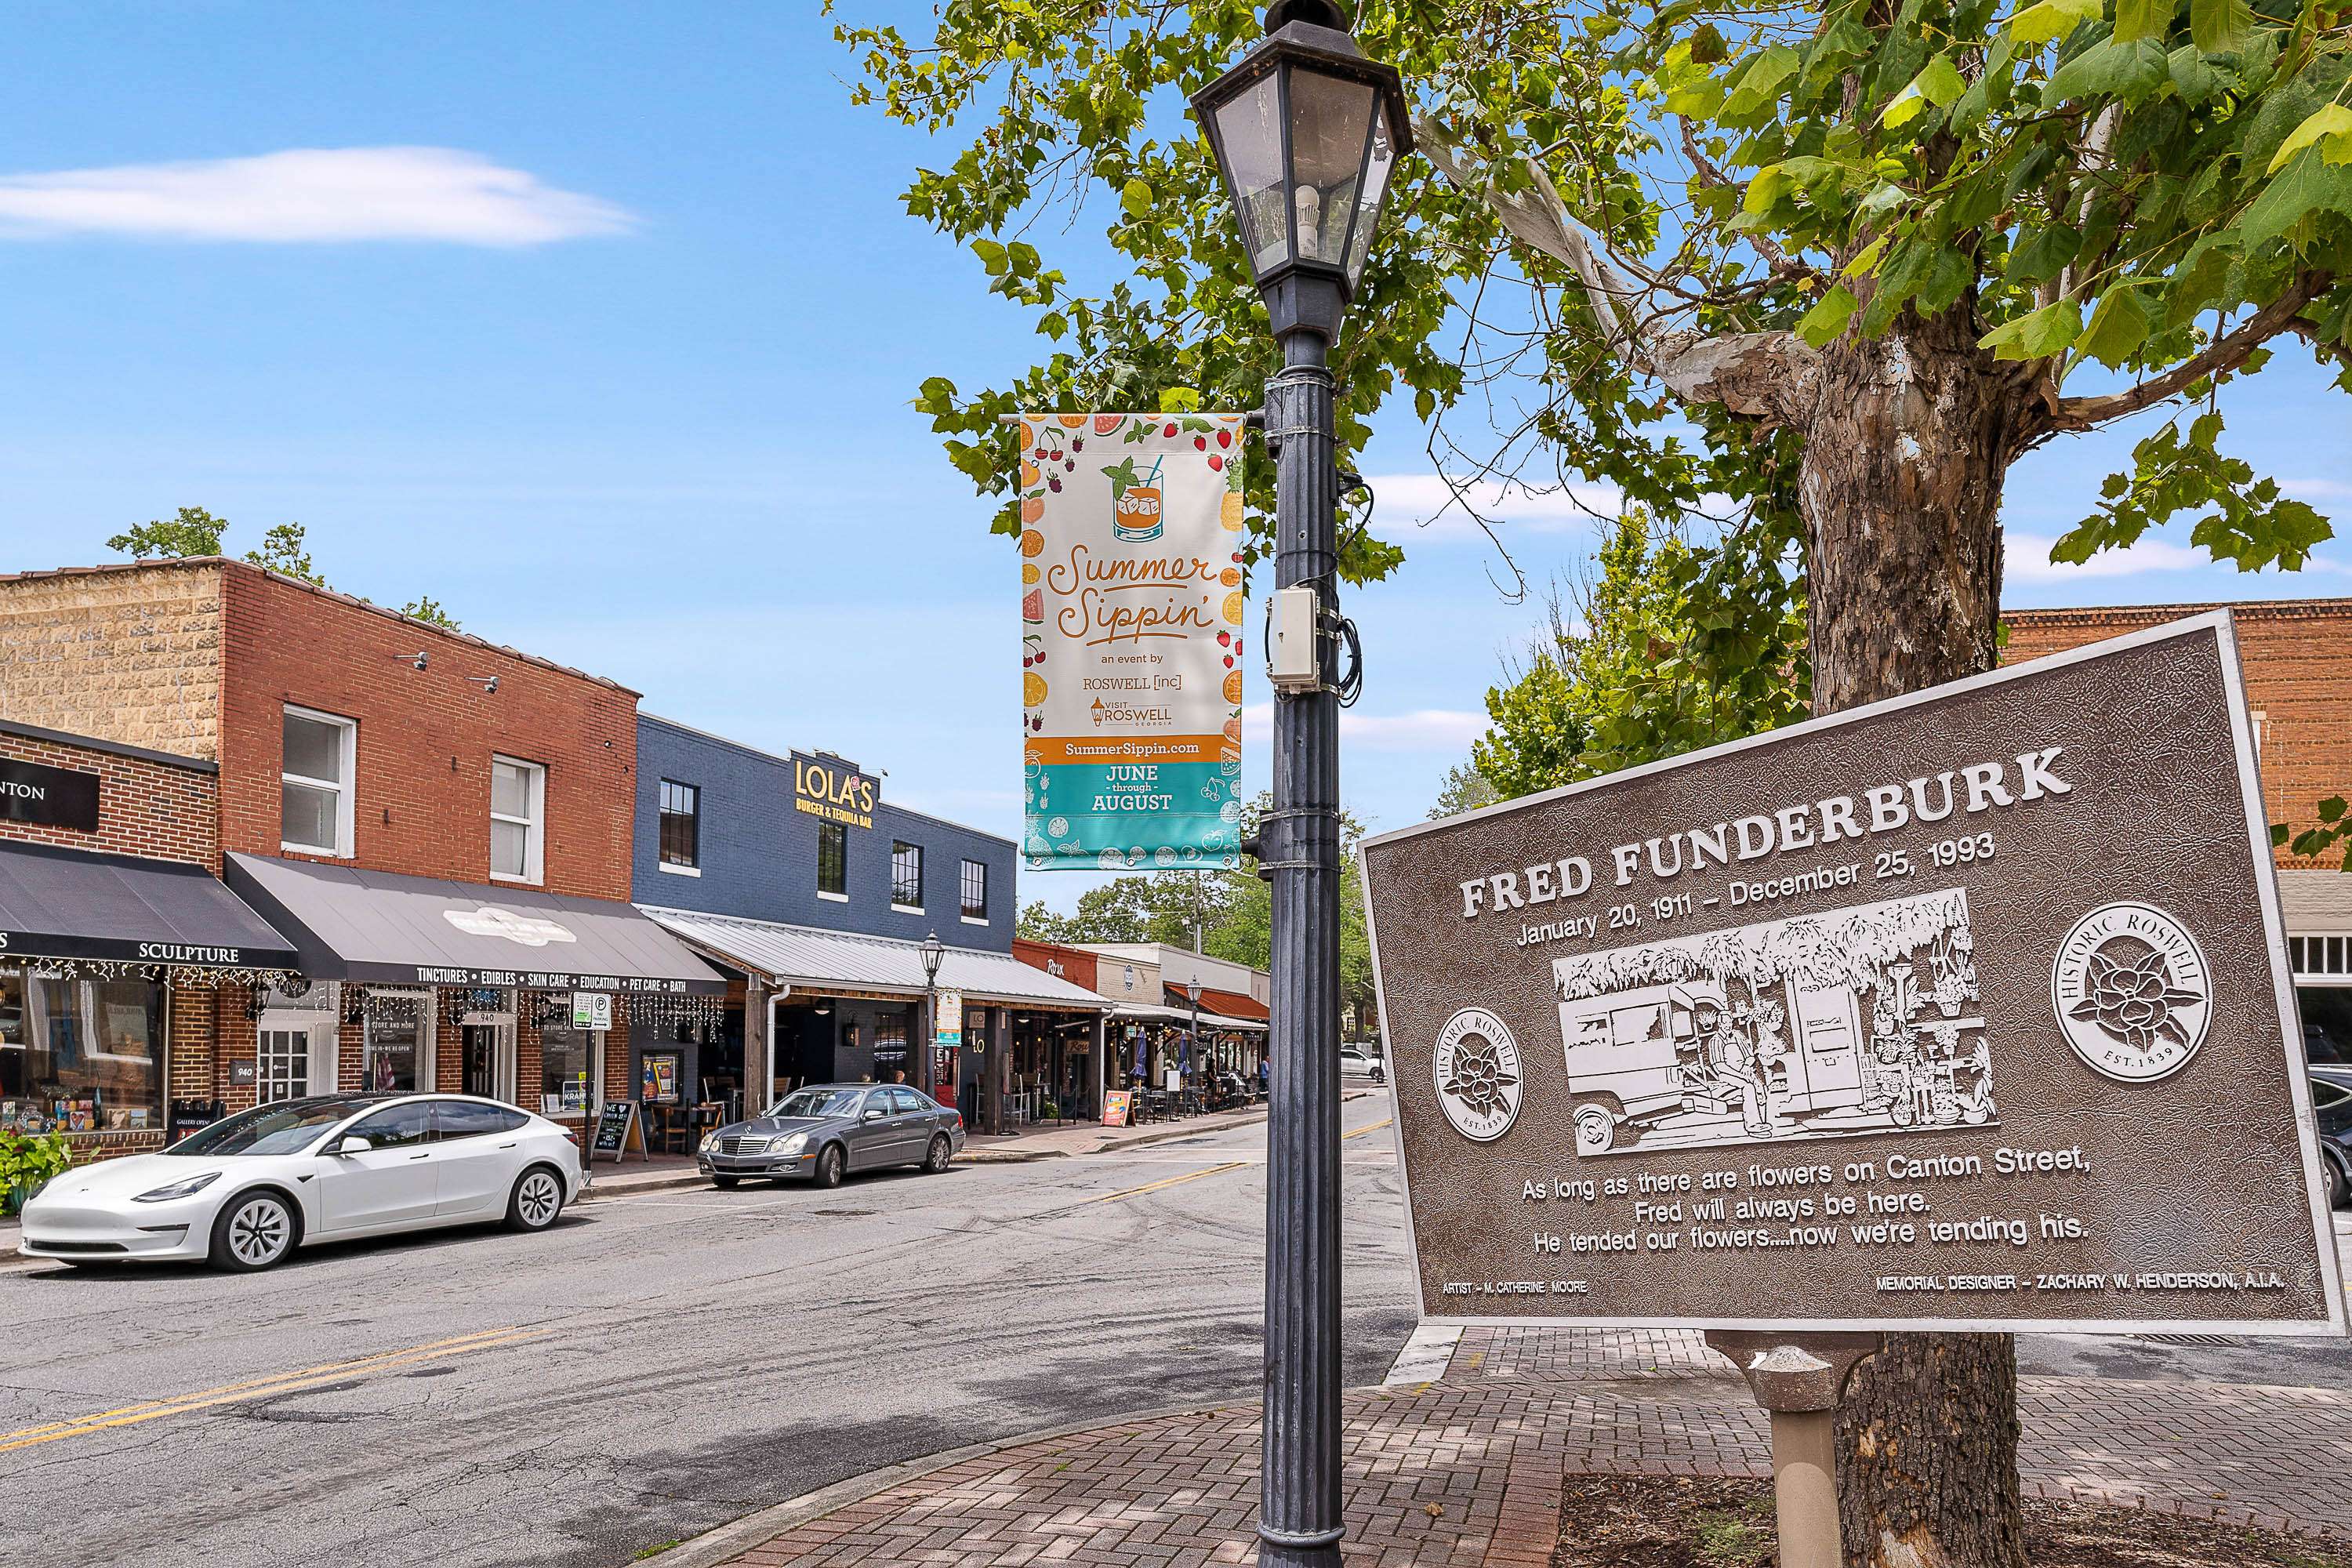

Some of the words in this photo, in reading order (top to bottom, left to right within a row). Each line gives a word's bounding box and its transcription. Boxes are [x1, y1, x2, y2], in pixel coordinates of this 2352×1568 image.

[1047, 544, 1217, 595] Summer
[1058, 588, 1214, 644] Sippin'
[1117, 655, 1146, 663] event
[1150, 654, 1163, 664] by
[1083, 678, 1150, 690] ROSWELL
[1105, 709, 1172, 721] ROSWELL
[1065, 742, 1200, 757] SummerSippin.com
[1106, 765, 1158, 781] JUNE
[1112, 782, 1152, 793] through
[1091, 794, 1173, 811] AUGUST
[796, 798, 825, 817] BURGER
[825, 807, 831, 818] &
[832, 808, 859, 826] TEQUILA
[859, 815, 873, 829] BAR
[1459, 857, 1592, 918] FRED
[1611, 747, 2071, 885] FUNDERBURK
[1517, 915, 1599, 947] January
[1608, 904, 1642, 929] 20,
[1650, 892, 1693, 920] 1911
[1729, 864, 1861, 906] December
[1875, 850, 1916, 879] 25,
[1928, 832, 1996, 868] 1993
[139, 942, 239, 963] SCULPTURE
[2062, 916, 2117, 999] HISTORIC
[2127, 914, 2198, 985] ROSWELL
[1047, 959, 1065, 976] Roux
[416, 967, 467, 984] TINCTURES
[481, 971, 516, 985] EDIBLES
[528, 973, 547, 987] SKIN
[549, 974, 569, 988] CARE
[580, 976, 620, 990] EDUCATION
[630, 978, 643, 991] PET
[643, 979, 661, 992] CARE
[670, 981, 686, 993] BATH
[480, 1014, 495, 1022] 940
[1439, 1018, 1469, 1078] HISTORIC
[1475, 1017, 1515, 1071] ROSWELL
[238, 1068, 252, 1076] 940
[1522, 1180, 1547, 1200] As
[1555, 1178, 1596, 1201] long
[1604, 1177, 1628, 1195] as
[1638, 1174, 1692, 1193] there
[1702, 1171, 1738, 1190] are
[1747, 1164, 1832, 1187] flowers
[1844, 1160, 1875, 1181] on
[1887, 1154, 1982, 1179] Canton
[1994, 1145, 2091, 1174] Street,
[1634, 1200, 1682, 1223] Fred
[1692, 1198, 1725, 1221] will
[1735, 1197, 1814, 1222] always
[1824, 1192, 1857, 1214] be
[1867, 1191, 1932, 1214] here.
[1534, 1232, 1561, 1253] He
[1570, 1229, 1638, 1251] tended
[1646, 1231, 1679, 1250] our
[1851, 1220, 1915, 1243] we're
[1928, 1217, 2028, 1245] tending
[2039, 1214, 2089, 1239] his.
[1443, 1283, 1473, 1294] ARTIST
[1484, 1283, 1494, 1293] M.
[1496, 1281, 1546, 1294] CATHERINE
[1551, 1280, 1588, 1293] MOORE
[1875, 1276, 1945, 1290] MEMORIAL
[1947, 1276, 2017, 1290] DESIGNER
[2036, 1274, 2107, 1290] ZACHARY
[2113, 1274, 2131, 1290] W.
[2136, 1272, 2240, 1290] HENDERSON,
[2245, 1272, 2285, 1289] A.I.A.
